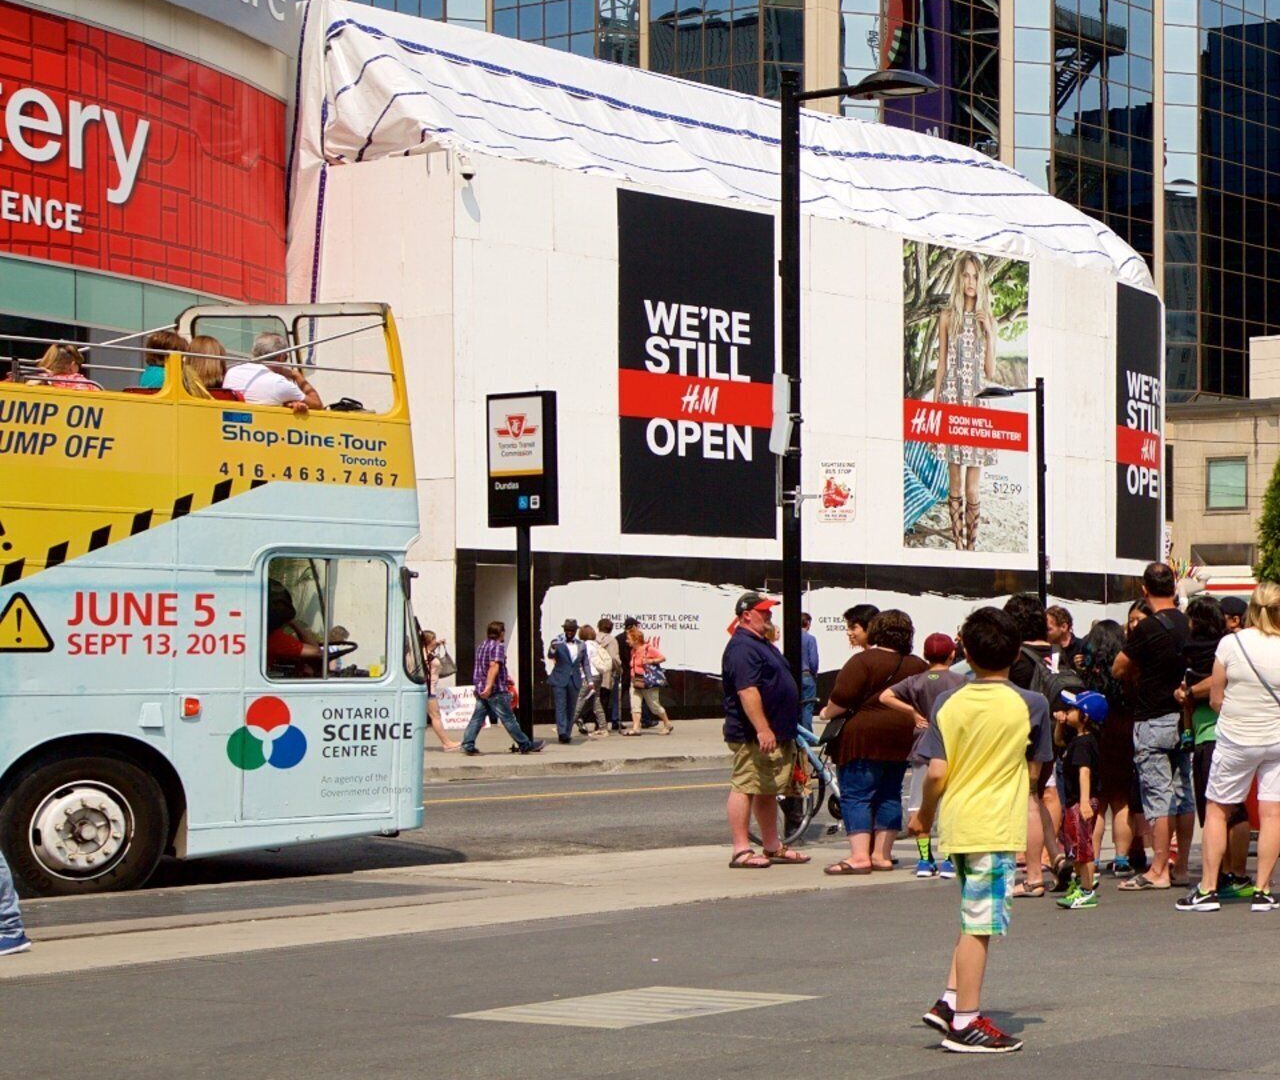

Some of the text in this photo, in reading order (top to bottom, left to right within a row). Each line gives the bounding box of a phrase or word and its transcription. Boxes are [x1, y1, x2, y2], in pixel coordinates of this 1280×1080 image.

[0, 190, 84, 235] ENCE
[644, 299, 752, 345] WE'RE
[644, 336, 752, 383] STILL
[681, 384, 720, 416] H&M
[67, 405, 104, 429] ON
[911, 408, 943, 437] H&M
[948, 415, 994, 429] SOON WE'LL
[646, 417, 753, 462] OPEN
[948, 426, 1022, 442] LOOK EVEN BETTER!
[64, 434, 116, 460] OFF
[498, 441, 536, 450] Toronto Transit
[340, 453, 388, 468] Toronto
[501, 450, 533, 458] Commission
[495, 482, 520, 490] Dundas
[993, 482, 1022, 495] $12.99
[1126, 464, 1159, 499] OPE
[67, 592, 216, 627] JUNE 5
[658, 614, 677, 622] STILL
[818, 617, 832, 626] GET
[665, 622, 678, 630] THE
[67, 634, 246, 658] SEPT 13, 2015
[322, 707, 390, 721] ONTARIO
[322, 722, 413, 743] SCIENCE
[322, 745, 379, 759] CENTRE
[321, 773, 388, 788] An agency of the
[320, 786, 413, 798] Government of Ontario
